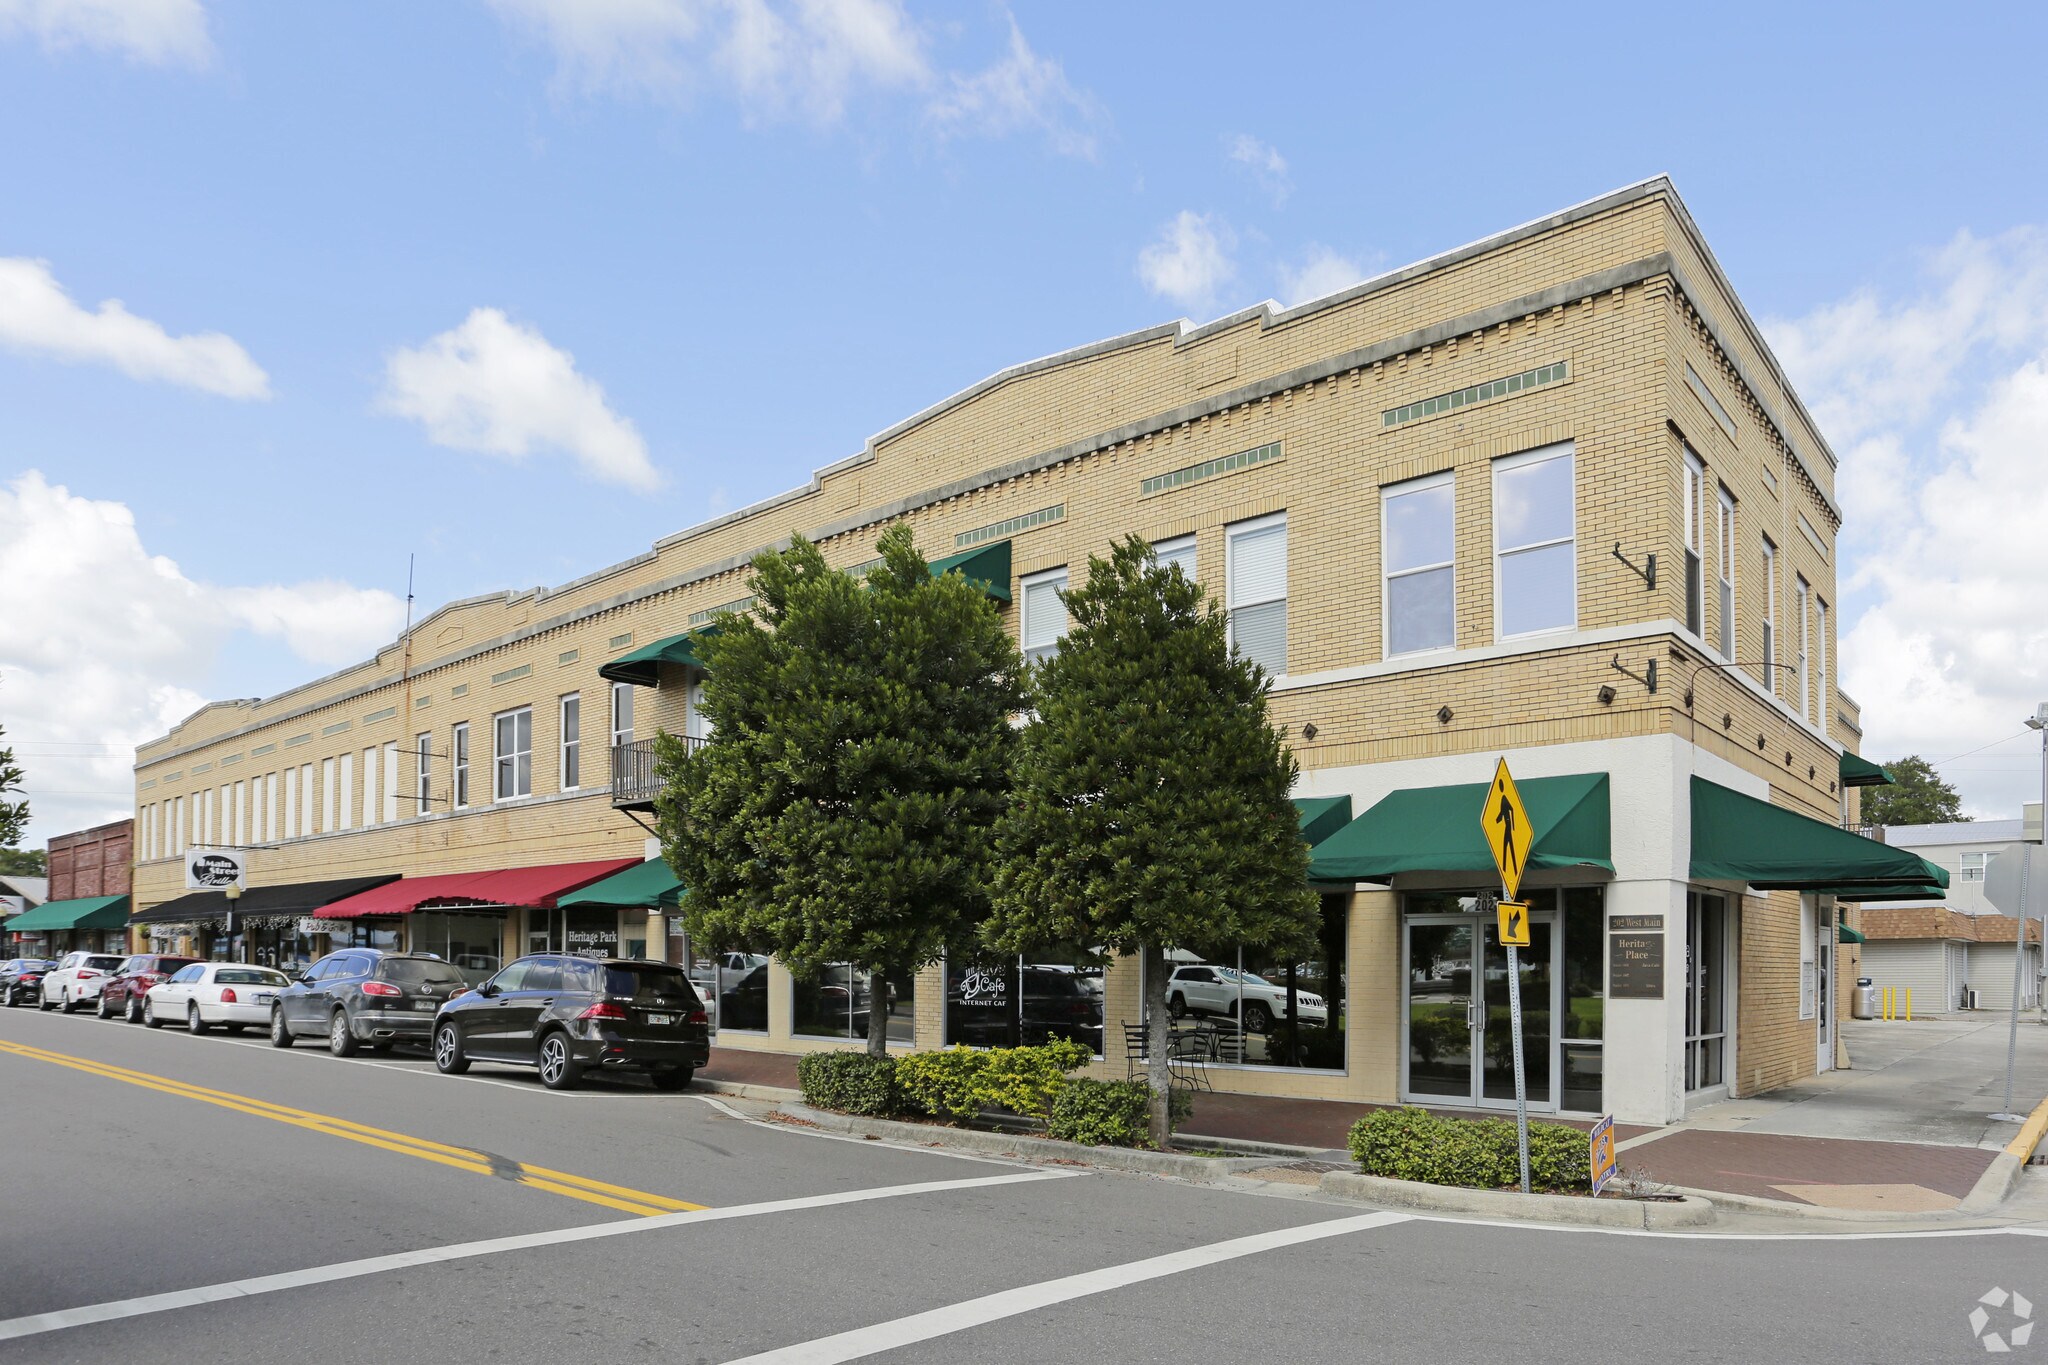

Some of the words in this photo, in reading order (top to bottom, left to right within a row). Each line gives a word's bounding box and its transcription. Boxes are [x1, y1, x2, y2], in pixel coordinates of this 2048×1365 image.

[205, 860, 232, 868] Main
[209, 867, 241, 875] Street
[1475, 900, 1494, 911] 202
[1626, 918, 1642, 927] West
[1644, 918, 1662, 927] Main
[568, 930, 599, 946] Heritage
[599, 930, 618, 943] Park
[1625, 950, 1649, 960] Place
[980, 976, 1006, 999] Cafe
[959, 999, 993, 1007] INTERNET
